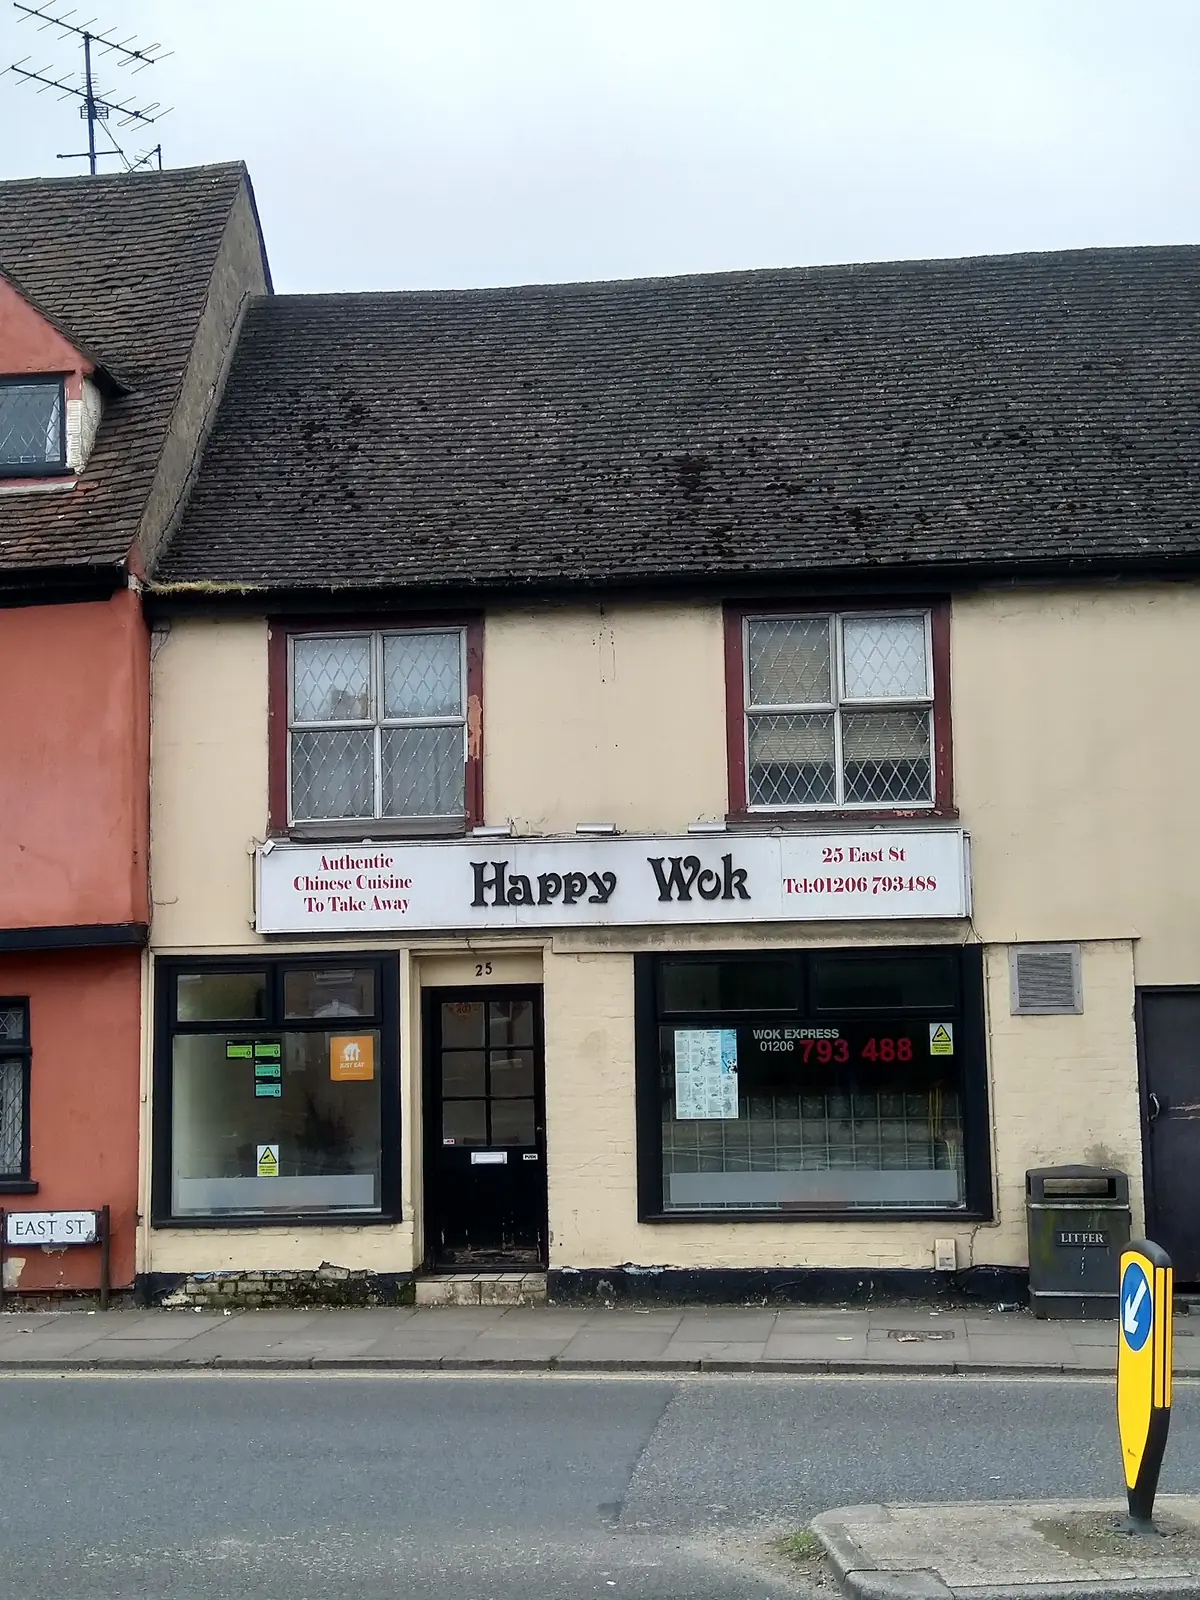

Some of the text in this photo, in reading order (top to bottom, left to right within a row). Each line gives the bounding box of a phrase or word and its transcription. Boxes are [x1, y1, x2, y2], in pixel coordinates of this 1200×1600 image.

[318, 853, 394, 871] Authentic
[822, 846, 907, 863] 25 East St
[293, 874, 413, 891] Chinese Cuisine
[469, 853, 751, 907] Happy Wok
[783, 876, 937, 894] Tel:01206 793488
[303, 895, 411, 914] To Take Away
[475, 962, 493, 976] 25
[752, 1028, 840, 1040] WOK EXPRESS
[760, 1040, 794, 1052] 01206
[799, 1038, 850, 1063] 793
[861, 1038, 914, 1062] 488
[15, 1220, 57, 1236] EAST
[1061, 1233, 1104, 1243] LITTER
